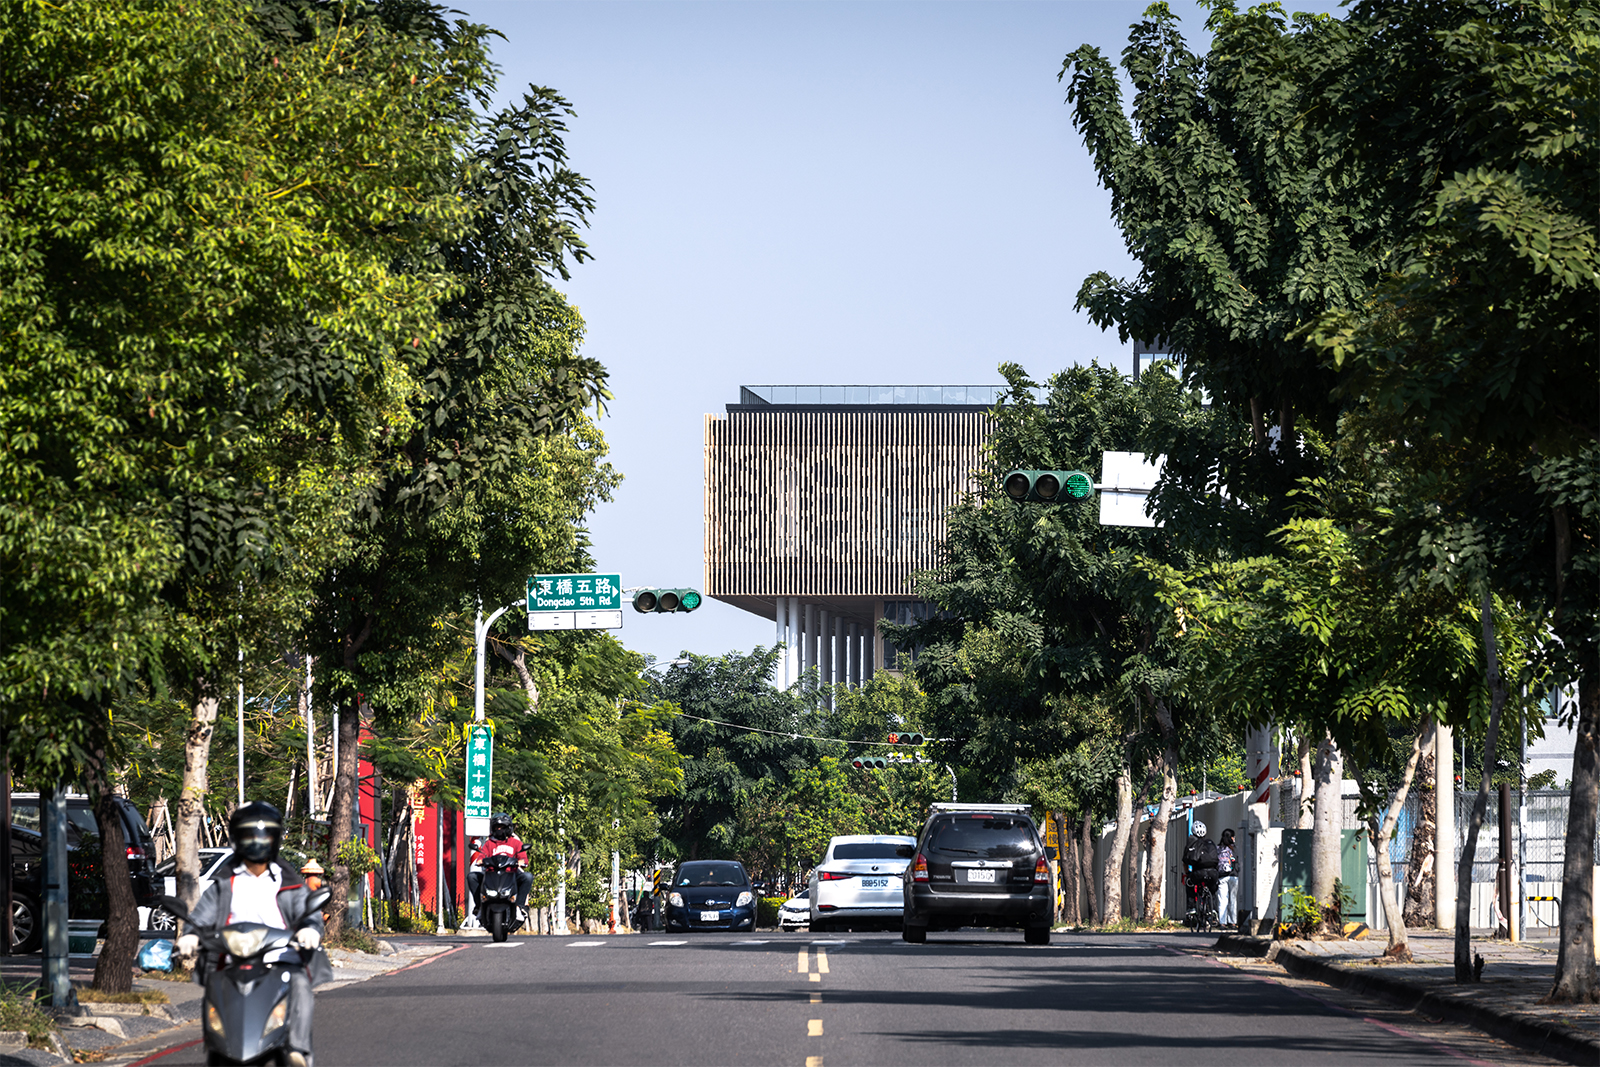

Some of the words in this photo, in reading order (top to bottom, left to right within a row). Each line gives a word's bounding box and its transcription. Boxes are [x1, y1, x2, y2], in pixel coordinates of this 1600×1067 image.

[537, 578, 611, 596] 東橋五路
[537, 597, 575, 609] Dongciao
[580, 596, 594, 605] 5th
[472, 737, 487, 798] 東橋十街
